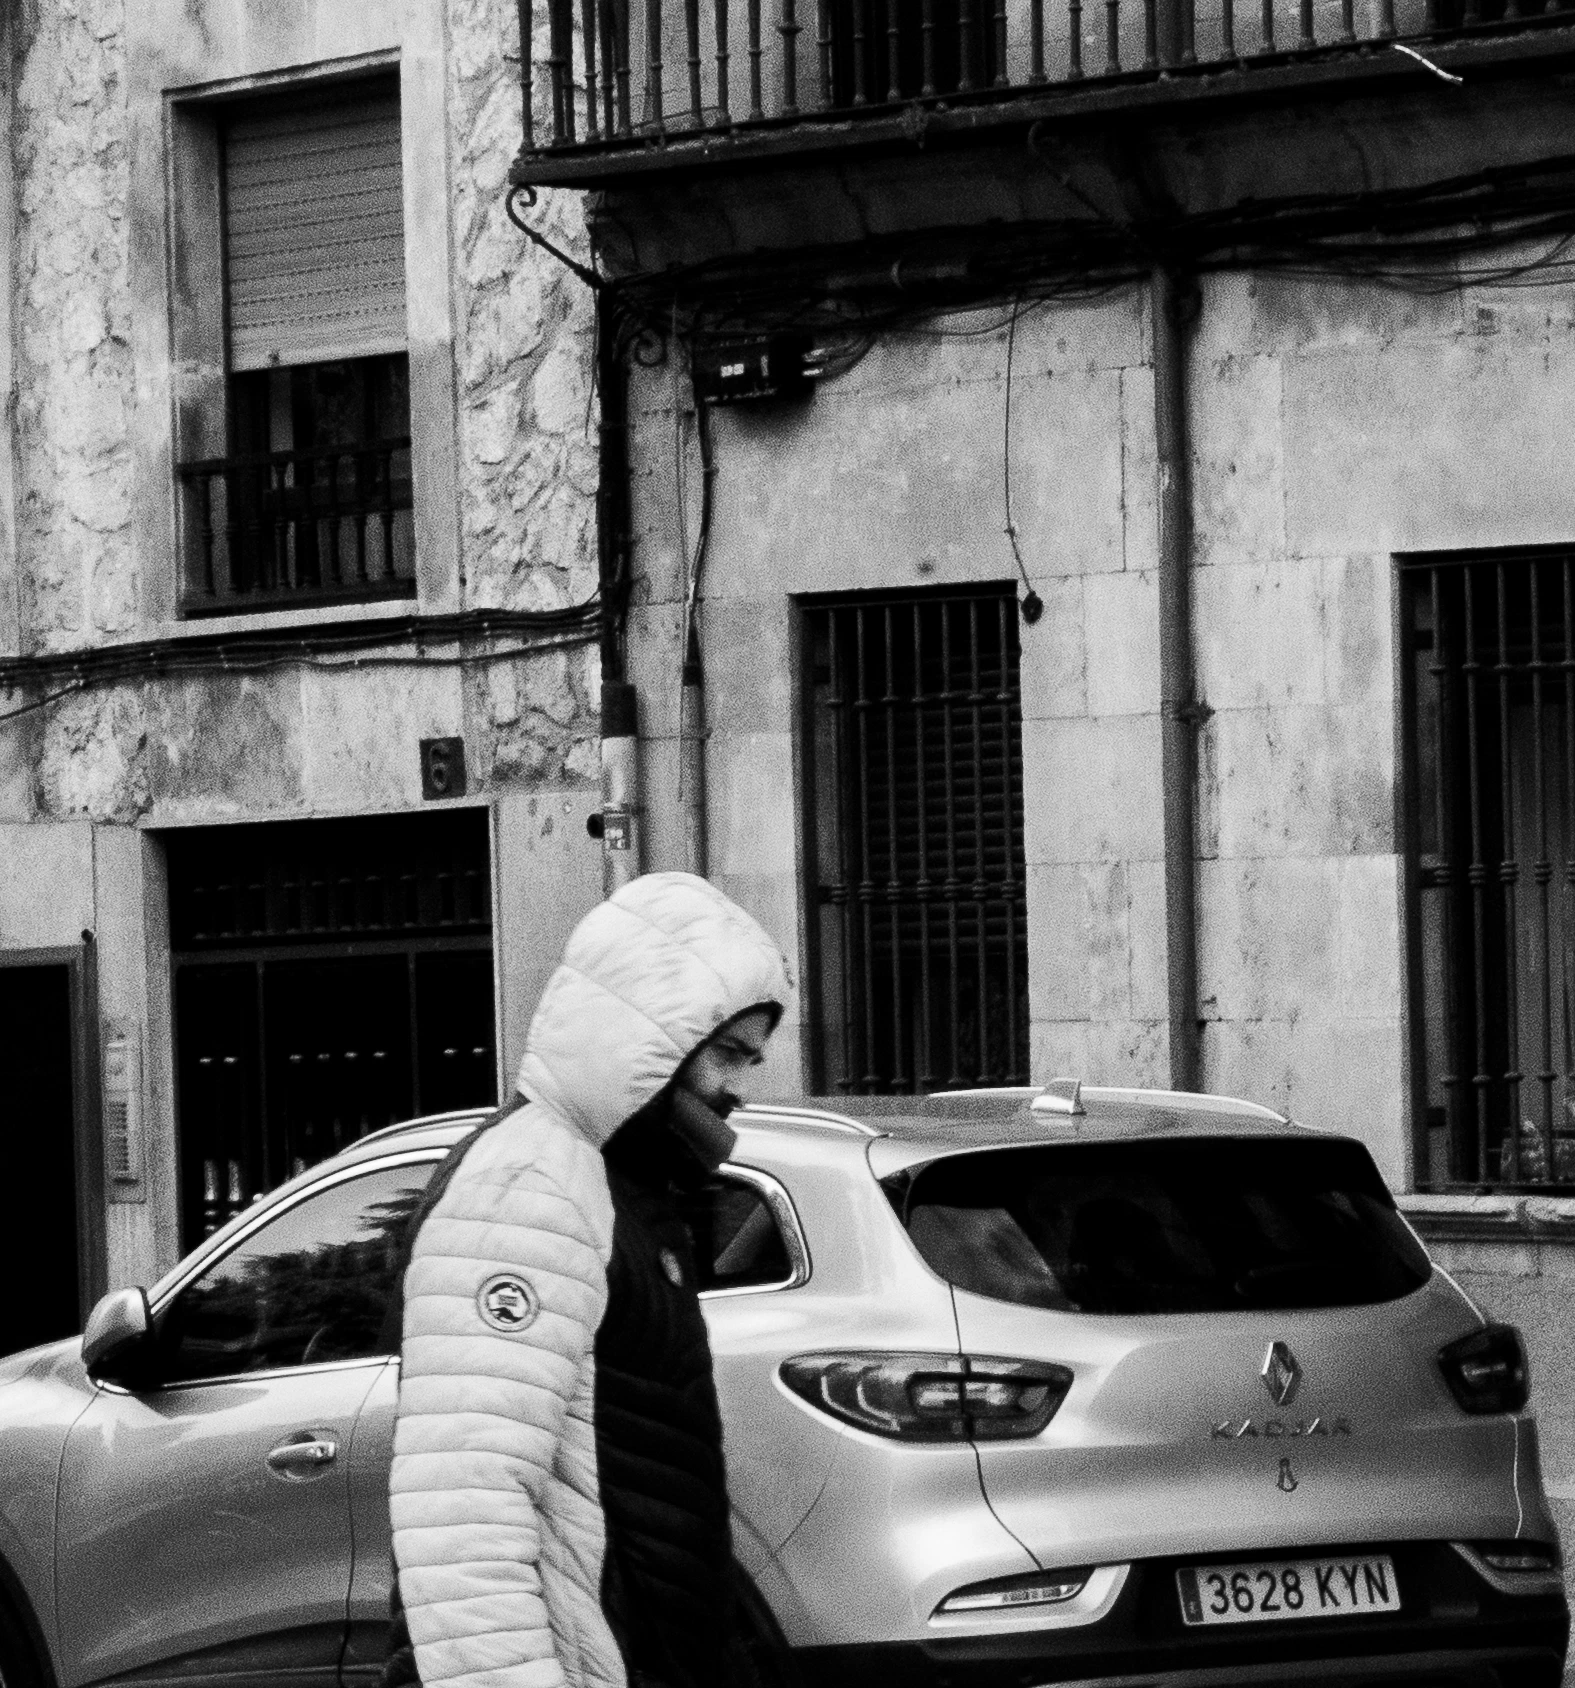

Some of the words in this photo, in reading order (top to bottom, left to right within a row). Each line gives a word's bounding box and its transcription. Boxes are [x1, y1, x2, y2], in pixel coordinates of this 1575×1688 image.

[429, 742, 450, 791] 6
[1206, 1569, 1304, 1615] 3628
[1314, 1562, 1390, 1608] KYN
